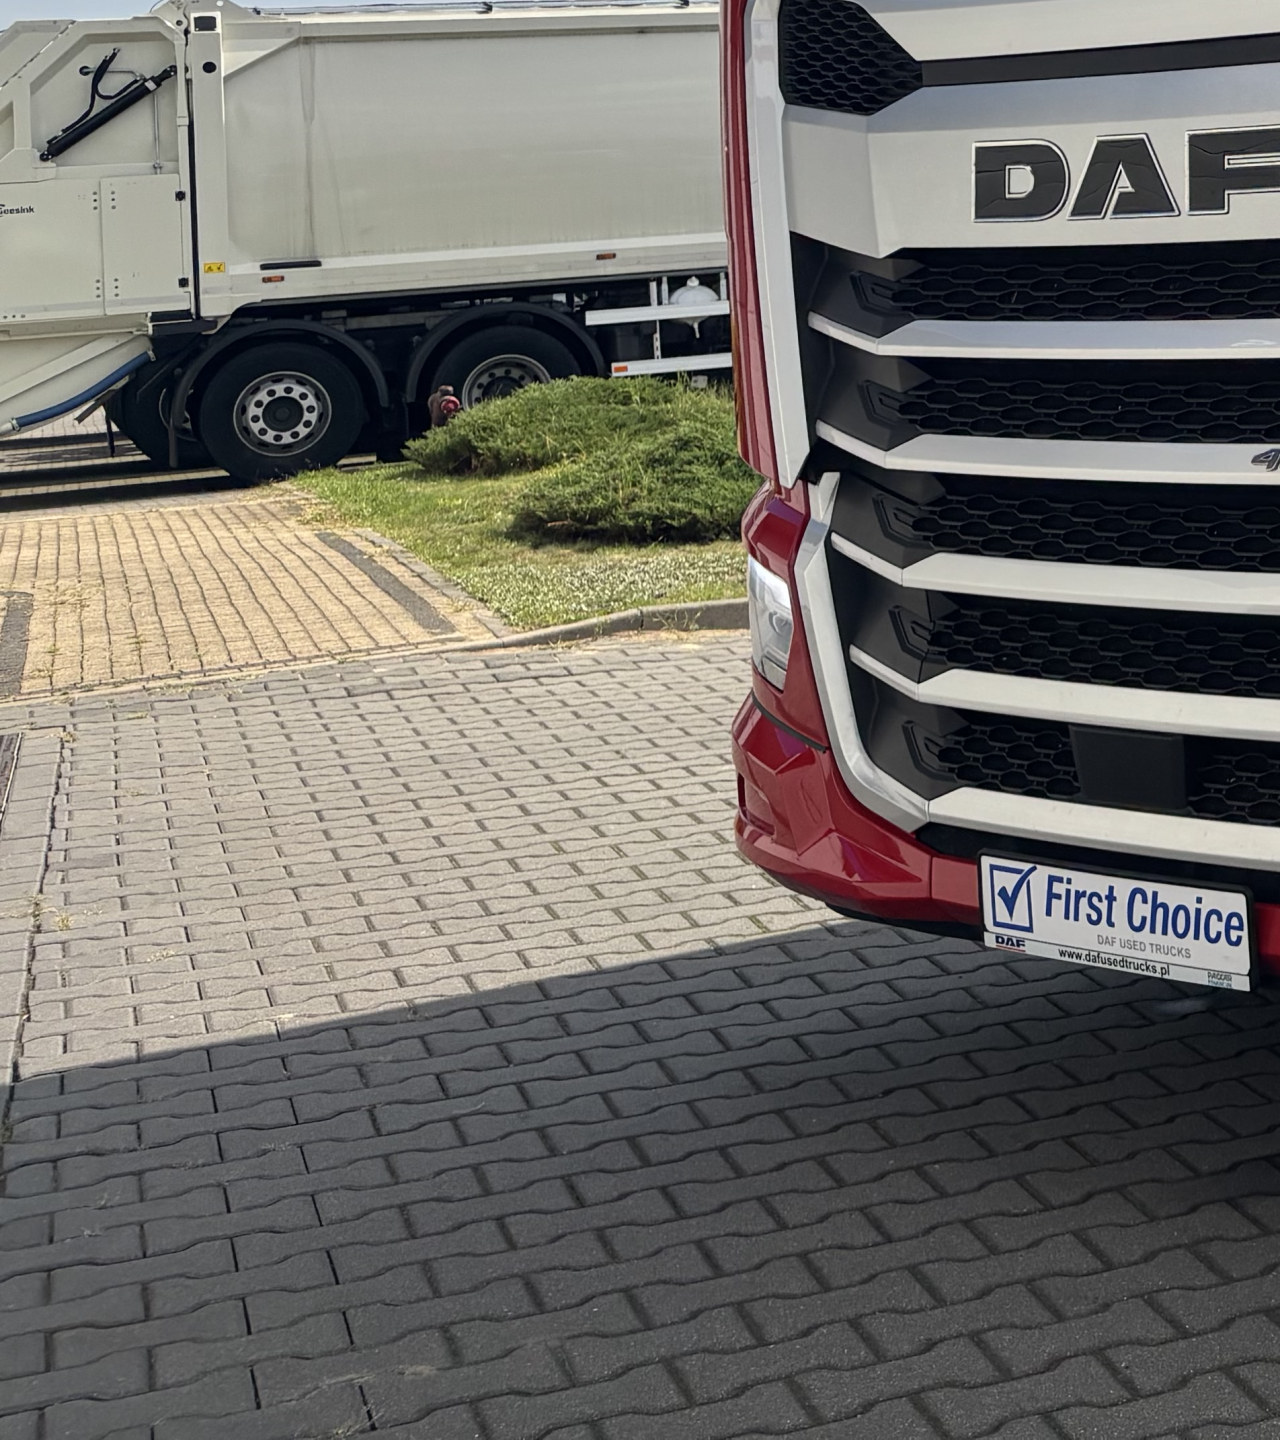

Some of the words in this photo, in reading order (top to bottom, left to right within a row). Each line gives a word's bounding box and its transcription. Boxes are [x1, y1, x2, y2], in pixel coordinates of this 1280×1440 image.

[1045, 874, 1116, 928] First
[1126, 886, 1245, 948] Choice
[995, 934, 1026, 949] DAF
[1097, 934, 1117, 947] DAF
[1119, 938, 1147, 952] USED
[1149, 942, 1191, 959] TRUCKS
[1058, 948, 1171, 978] www.dafusedtrucks.pl
